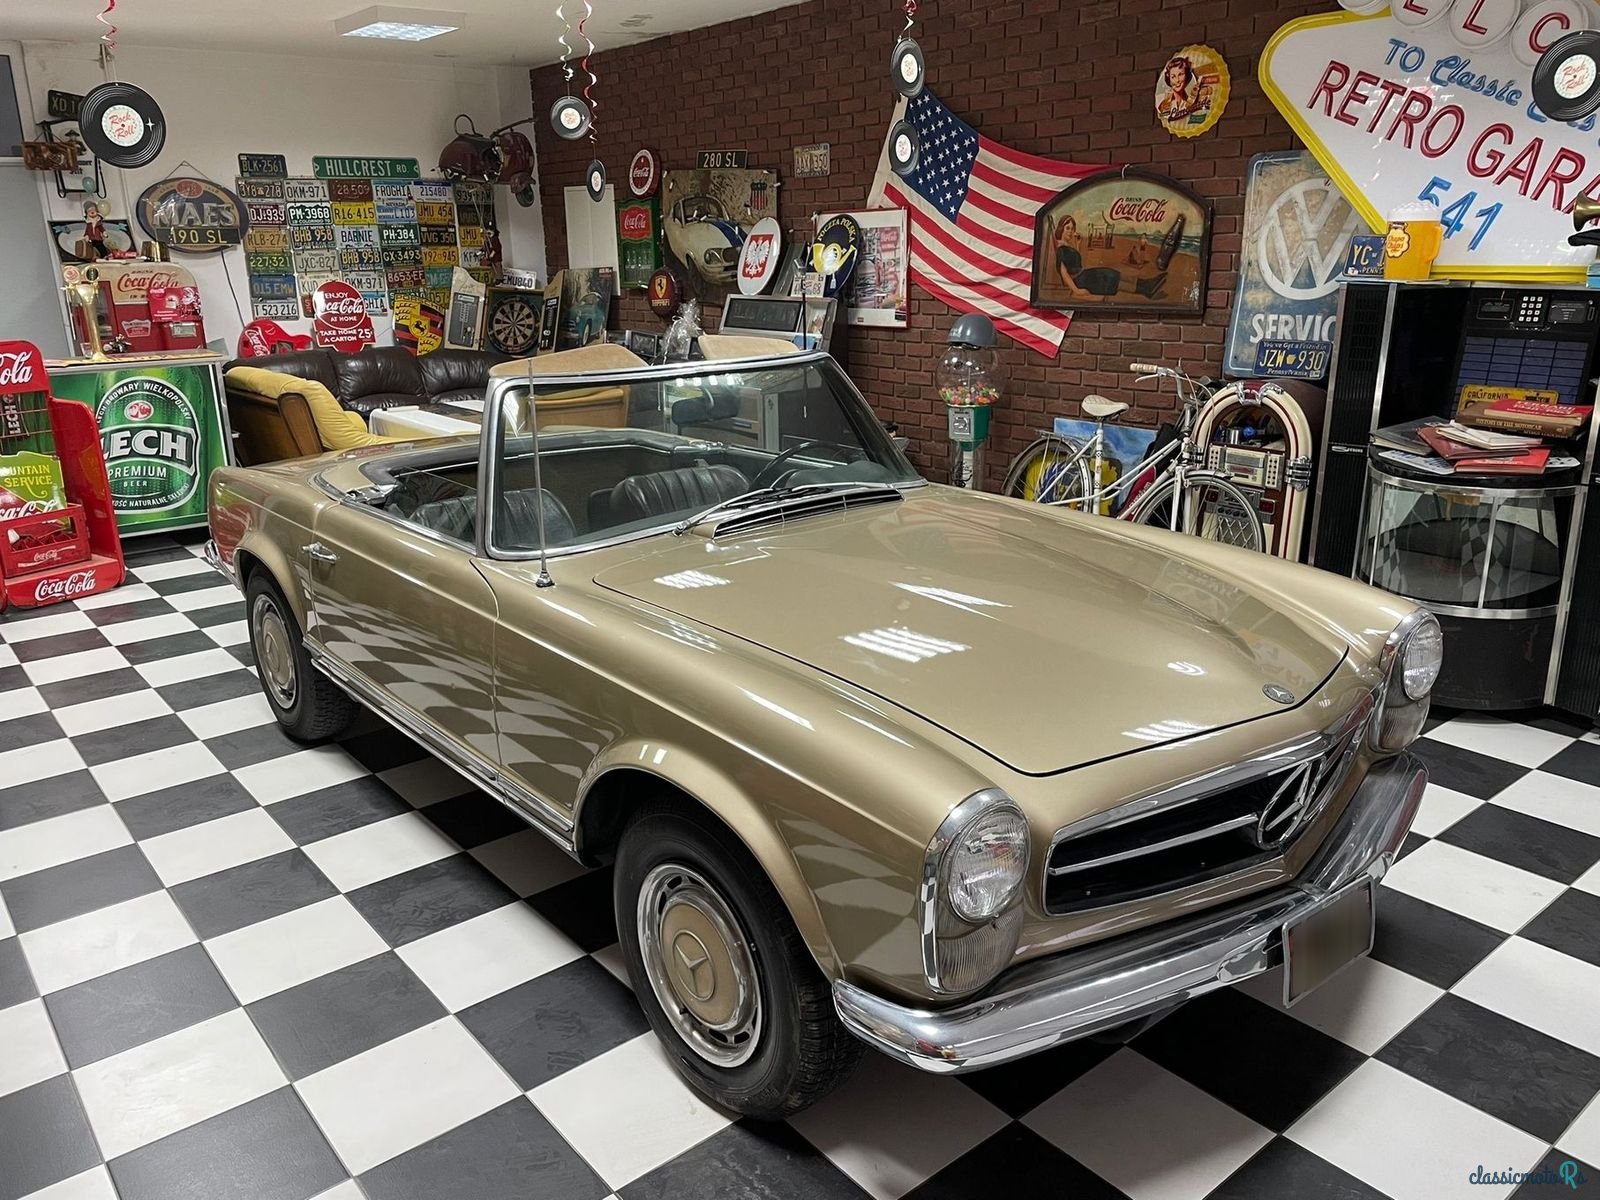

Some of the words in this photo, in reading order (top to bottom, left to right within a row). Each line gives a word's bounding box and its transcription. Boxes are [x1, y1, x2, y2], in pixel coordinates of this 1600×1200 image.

[1384, 38, 1425, 72] TO
[1430, 56, 1522, 106] Classic
[1306, 60, 1465, 159] RETRO
[109, 112, 132, 125] Rock
[114, 125, 136, 139] Roll
[326, 159, 392, 177] HILLCREST
[703, 152, 722, 168] 280
[725, 152, 738, 168] SL
[153, 201, 239, 227] MAES
[1109, 197, 1169, 223] Coca-Cola
[624, 212, 647, 230] Coca-Cola
[207, 229, 228, 244] SL
[341, 230, 374, 243] BARNIE
[117, 271, 179, 292] Coca-Cola
[325, 291, 349, 300] ENJOY
[326, 297, 364, 315] ca-Cola
[143, 382, 192, 420] WIELKOPOLSKI
[3, 464, 51, 477] UNTAIN
[4, 475, 54, 490] SERVICE
[123, 480, 148, 488] BEER
[129, 497, 168, 508] NATURALNE
[35, 569, 97, 602] Coca-Cola
